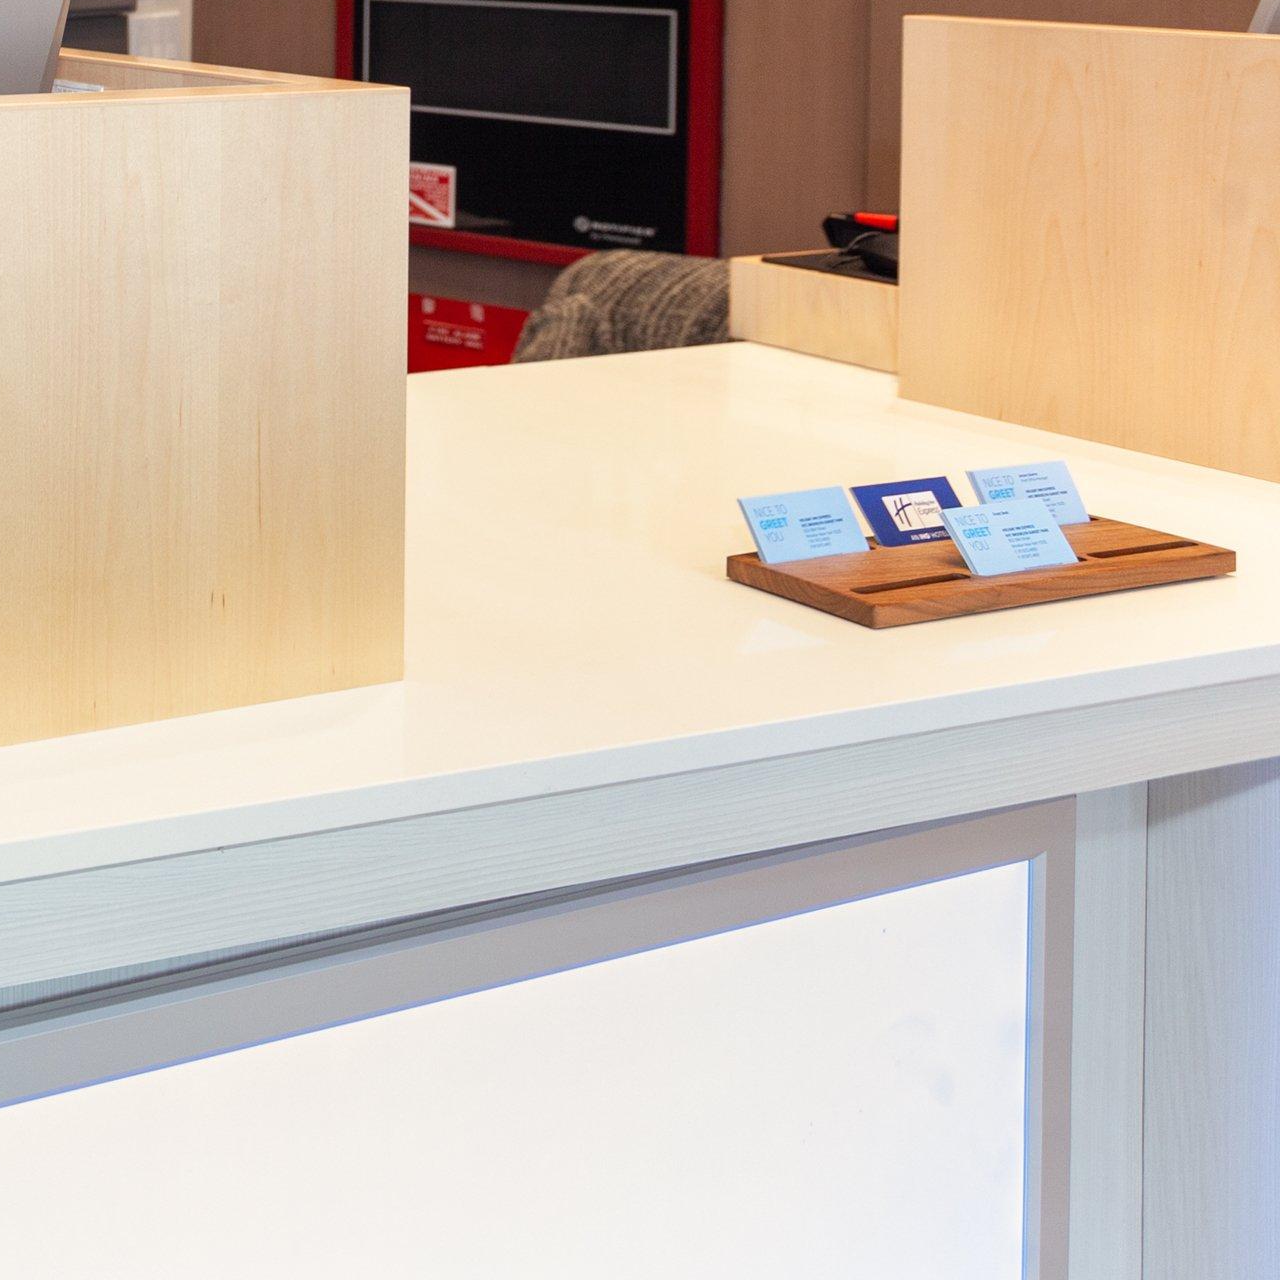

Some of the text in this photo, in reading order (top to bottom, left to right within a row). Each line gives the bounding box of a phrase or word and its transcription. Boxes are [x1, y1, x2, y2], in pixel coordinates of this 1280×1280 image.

[988, 487, 1015, 500] GREET
[760, 517, 788, 530] GREET
[962, 526, 992, 539] GREET
[969, 540, 990, 551] YOU
